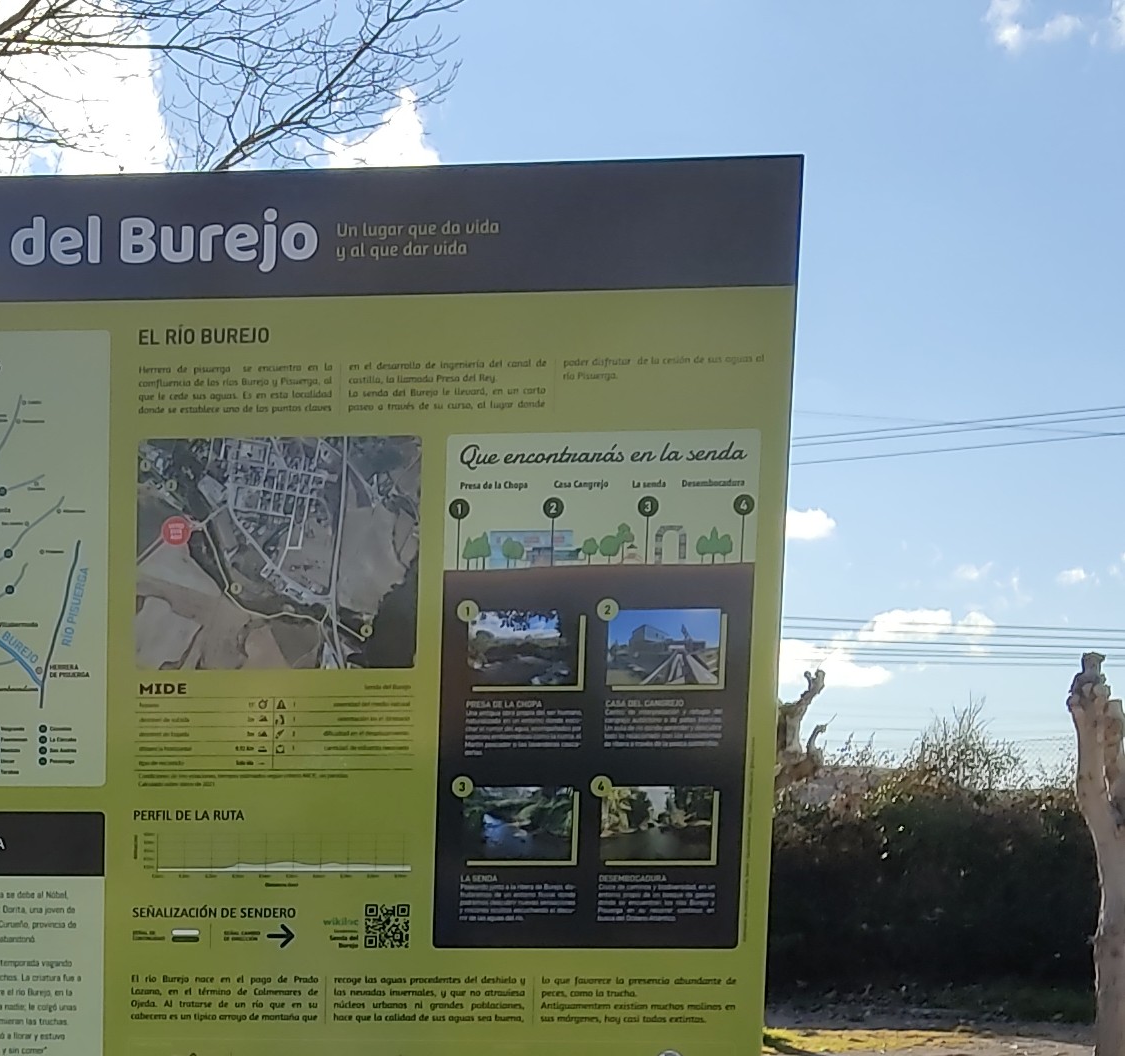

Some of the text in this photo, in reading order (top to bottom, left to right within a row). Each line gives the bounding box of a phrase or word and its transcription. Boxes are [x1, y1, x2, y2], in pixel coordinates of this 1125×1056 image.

[336, 219, 500, 242] Un lugar que da vida
[10, 216, 101, 266] del
[119, 208, 319, 272] Burejo
[336, 240, 468, 262] y al que dar vida
[139, 324, 270, 345] EL RÍO BUREJO
[459, 441, 747, 471] Que encontrarás en la senda
[554, 479, 609, 490] Casa Cangrejo
[632, 479, 666, 489] La senda
[682, 479, 745, 488] Desembocadura
[549, 503, 558, 514] 2
[644, 501, 652, 512] 3
[739, 500, 748, 510] 4
[61, 567, 89, 647] RÍO PISUERGA
[0, 631, 39, 664] BUREJO
[139, 683, 187, 695] MIDE
[133, 810, 244, 821] PERFIL DE LA RUTA
[132, 905, 296, 918] SEÑALIZACIÓN DE SENDERO
[131, 975, 139, 983] El
[145, 975, 156, 983] río
[162, 975, 189, 985] Burejo
[237, 975, 244, 984] el
[250, 976, 272, 985] pago
[278, 975, 288, 984] de
[293, 975, 319, 984] Prado
[334, 976, 525, 986] recoge las aguas procedentes del deshielo y
[164, 1000, 173, 1008] Al
[179, 1000, 213, 1008] tratarse
[218, 1000, 228, 1008] de
[252, 1000, 263, 1009] río
[269, 1001, 285, 1010] que
[292, 1001, 302, 1009] en
[308, 1001, 318, 1009] su
[333, 1013, 353, 1022] hace
[355, 1014, 371, 1023] que
[374, 1013, 382, 1022] la
[384, 1013, 416, 1022] calidad
[418, 1013, 429, 1022] de
[432, 1014, 446, 1022] sus
[449, 1014, 475, 1023] aguas
[477, 1014, 492, 1022] sea
